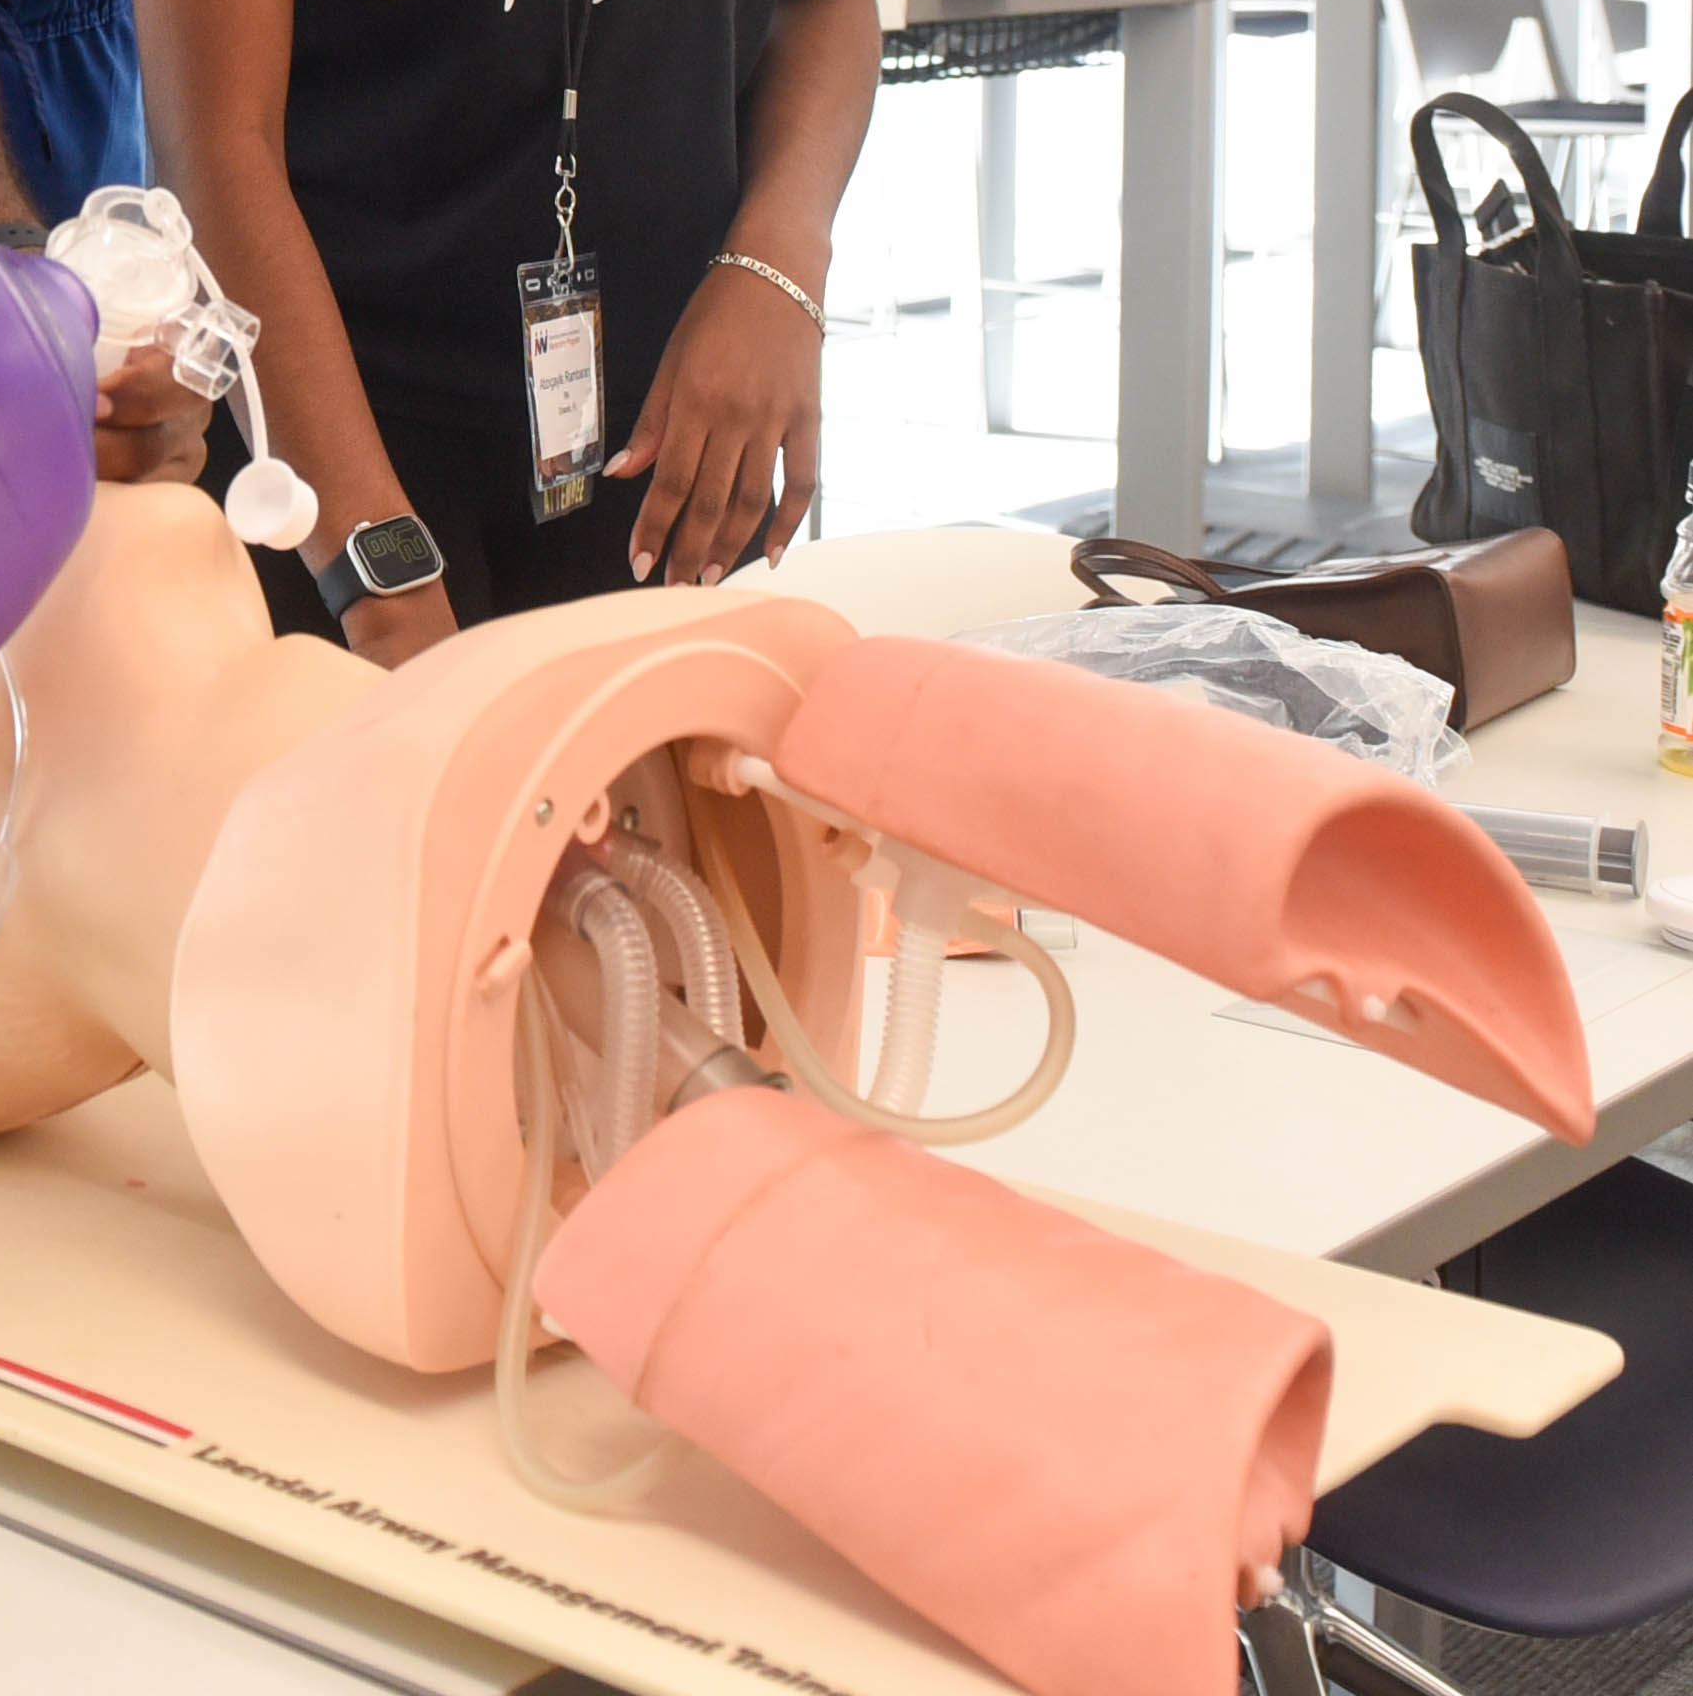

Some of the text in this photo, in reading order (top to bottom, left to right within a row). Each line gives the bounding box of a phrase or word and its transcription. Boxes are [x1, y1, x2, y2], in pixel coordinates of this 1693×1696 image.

[191, 1445, 855, 1695] Laerdal Airway Management Train
